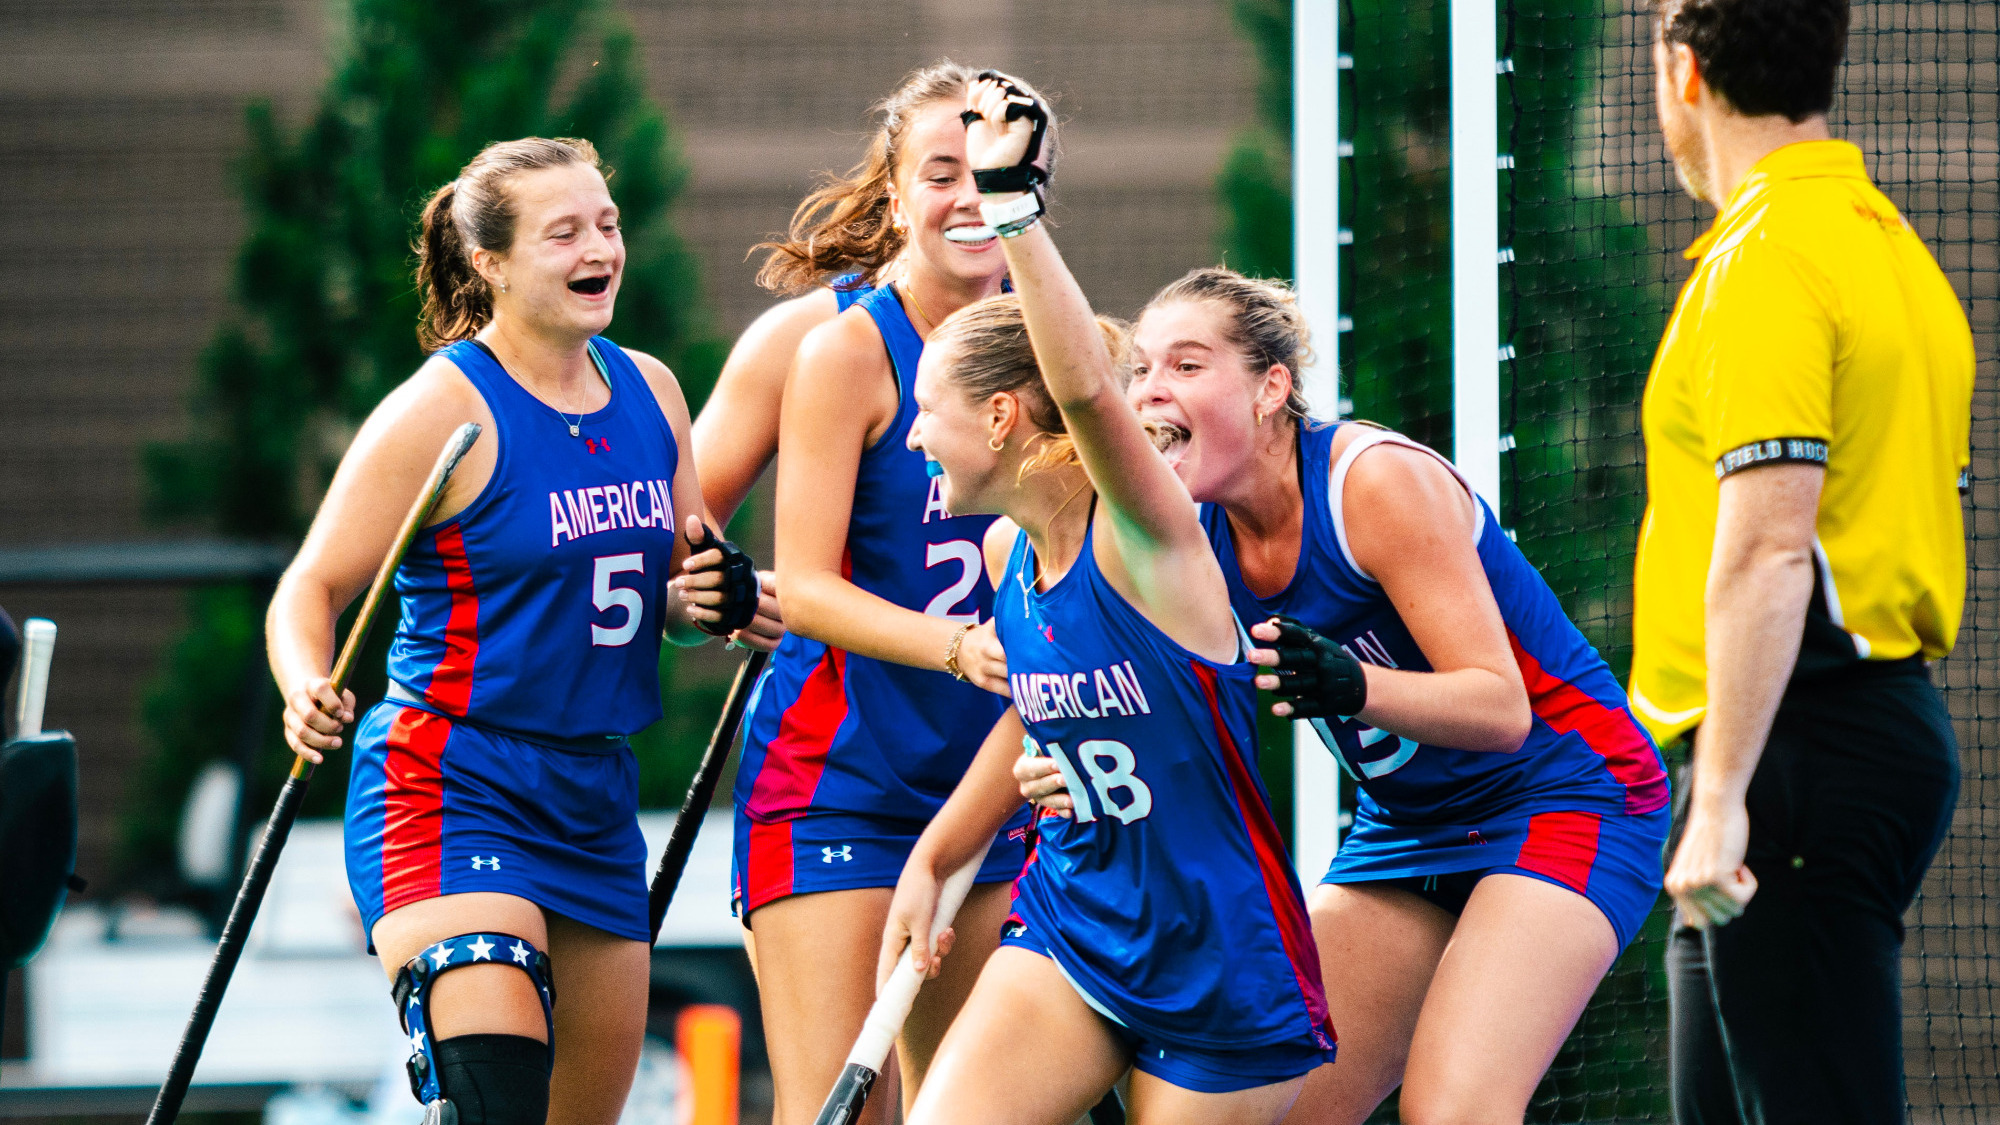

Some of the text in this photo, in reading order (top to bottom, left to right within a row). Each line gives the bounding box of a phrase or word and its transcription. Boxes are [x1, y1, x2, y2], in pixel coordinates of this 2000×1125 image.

[1724, 440, 1782, 471] FIELD
[549, 479, 675, 548] AMERICAN
[590, 552, 645, 648] 5
[1046, 738, 1153, 826] 18
